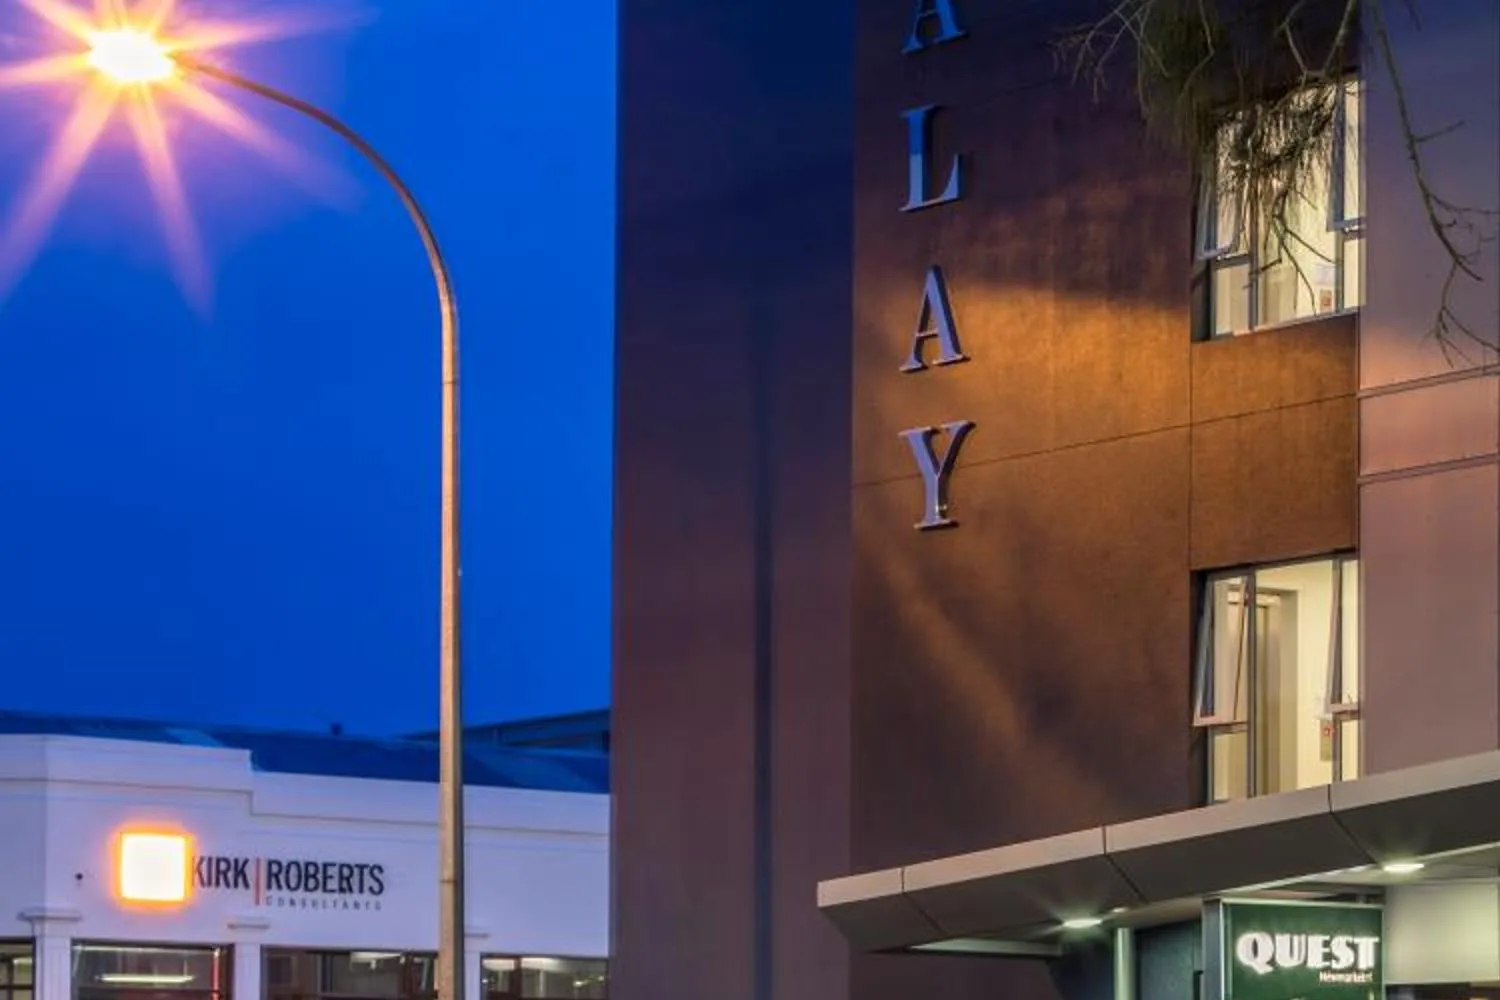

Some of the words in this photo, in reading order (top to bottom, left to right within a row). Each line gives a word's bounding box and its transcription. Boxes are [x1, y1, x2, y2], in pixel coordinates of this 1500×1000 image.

[191, 856, 250, 890] KIRK
[266, 859, 385, 896] ROBERTS
[1237, 932, 1380, 974] QUEST
